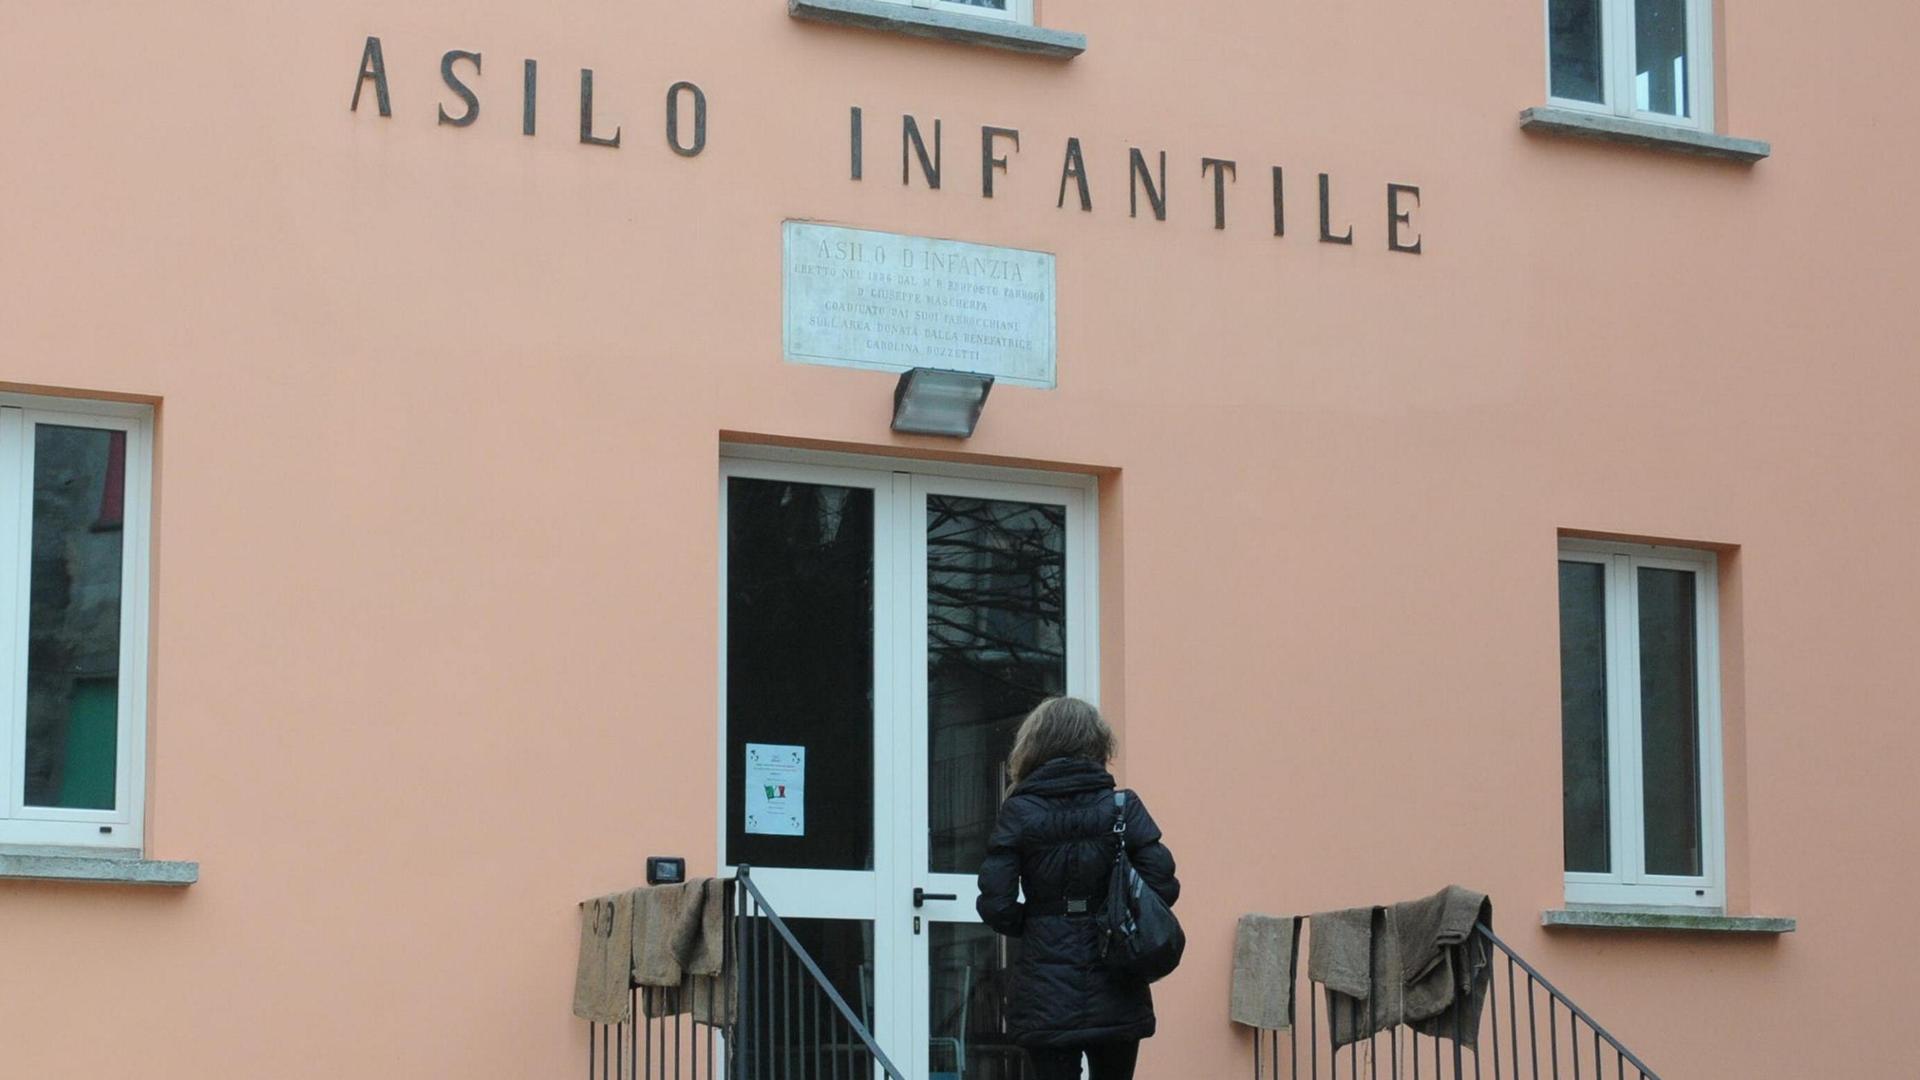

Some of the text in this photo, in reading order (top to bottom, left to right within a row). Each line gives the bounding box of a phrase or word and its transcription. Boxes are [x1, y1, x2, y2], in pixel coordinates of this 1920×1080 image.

[350, 36, 1422, 255] ASILO INFANTILE
[818, 239, 885, 264] ASILO
